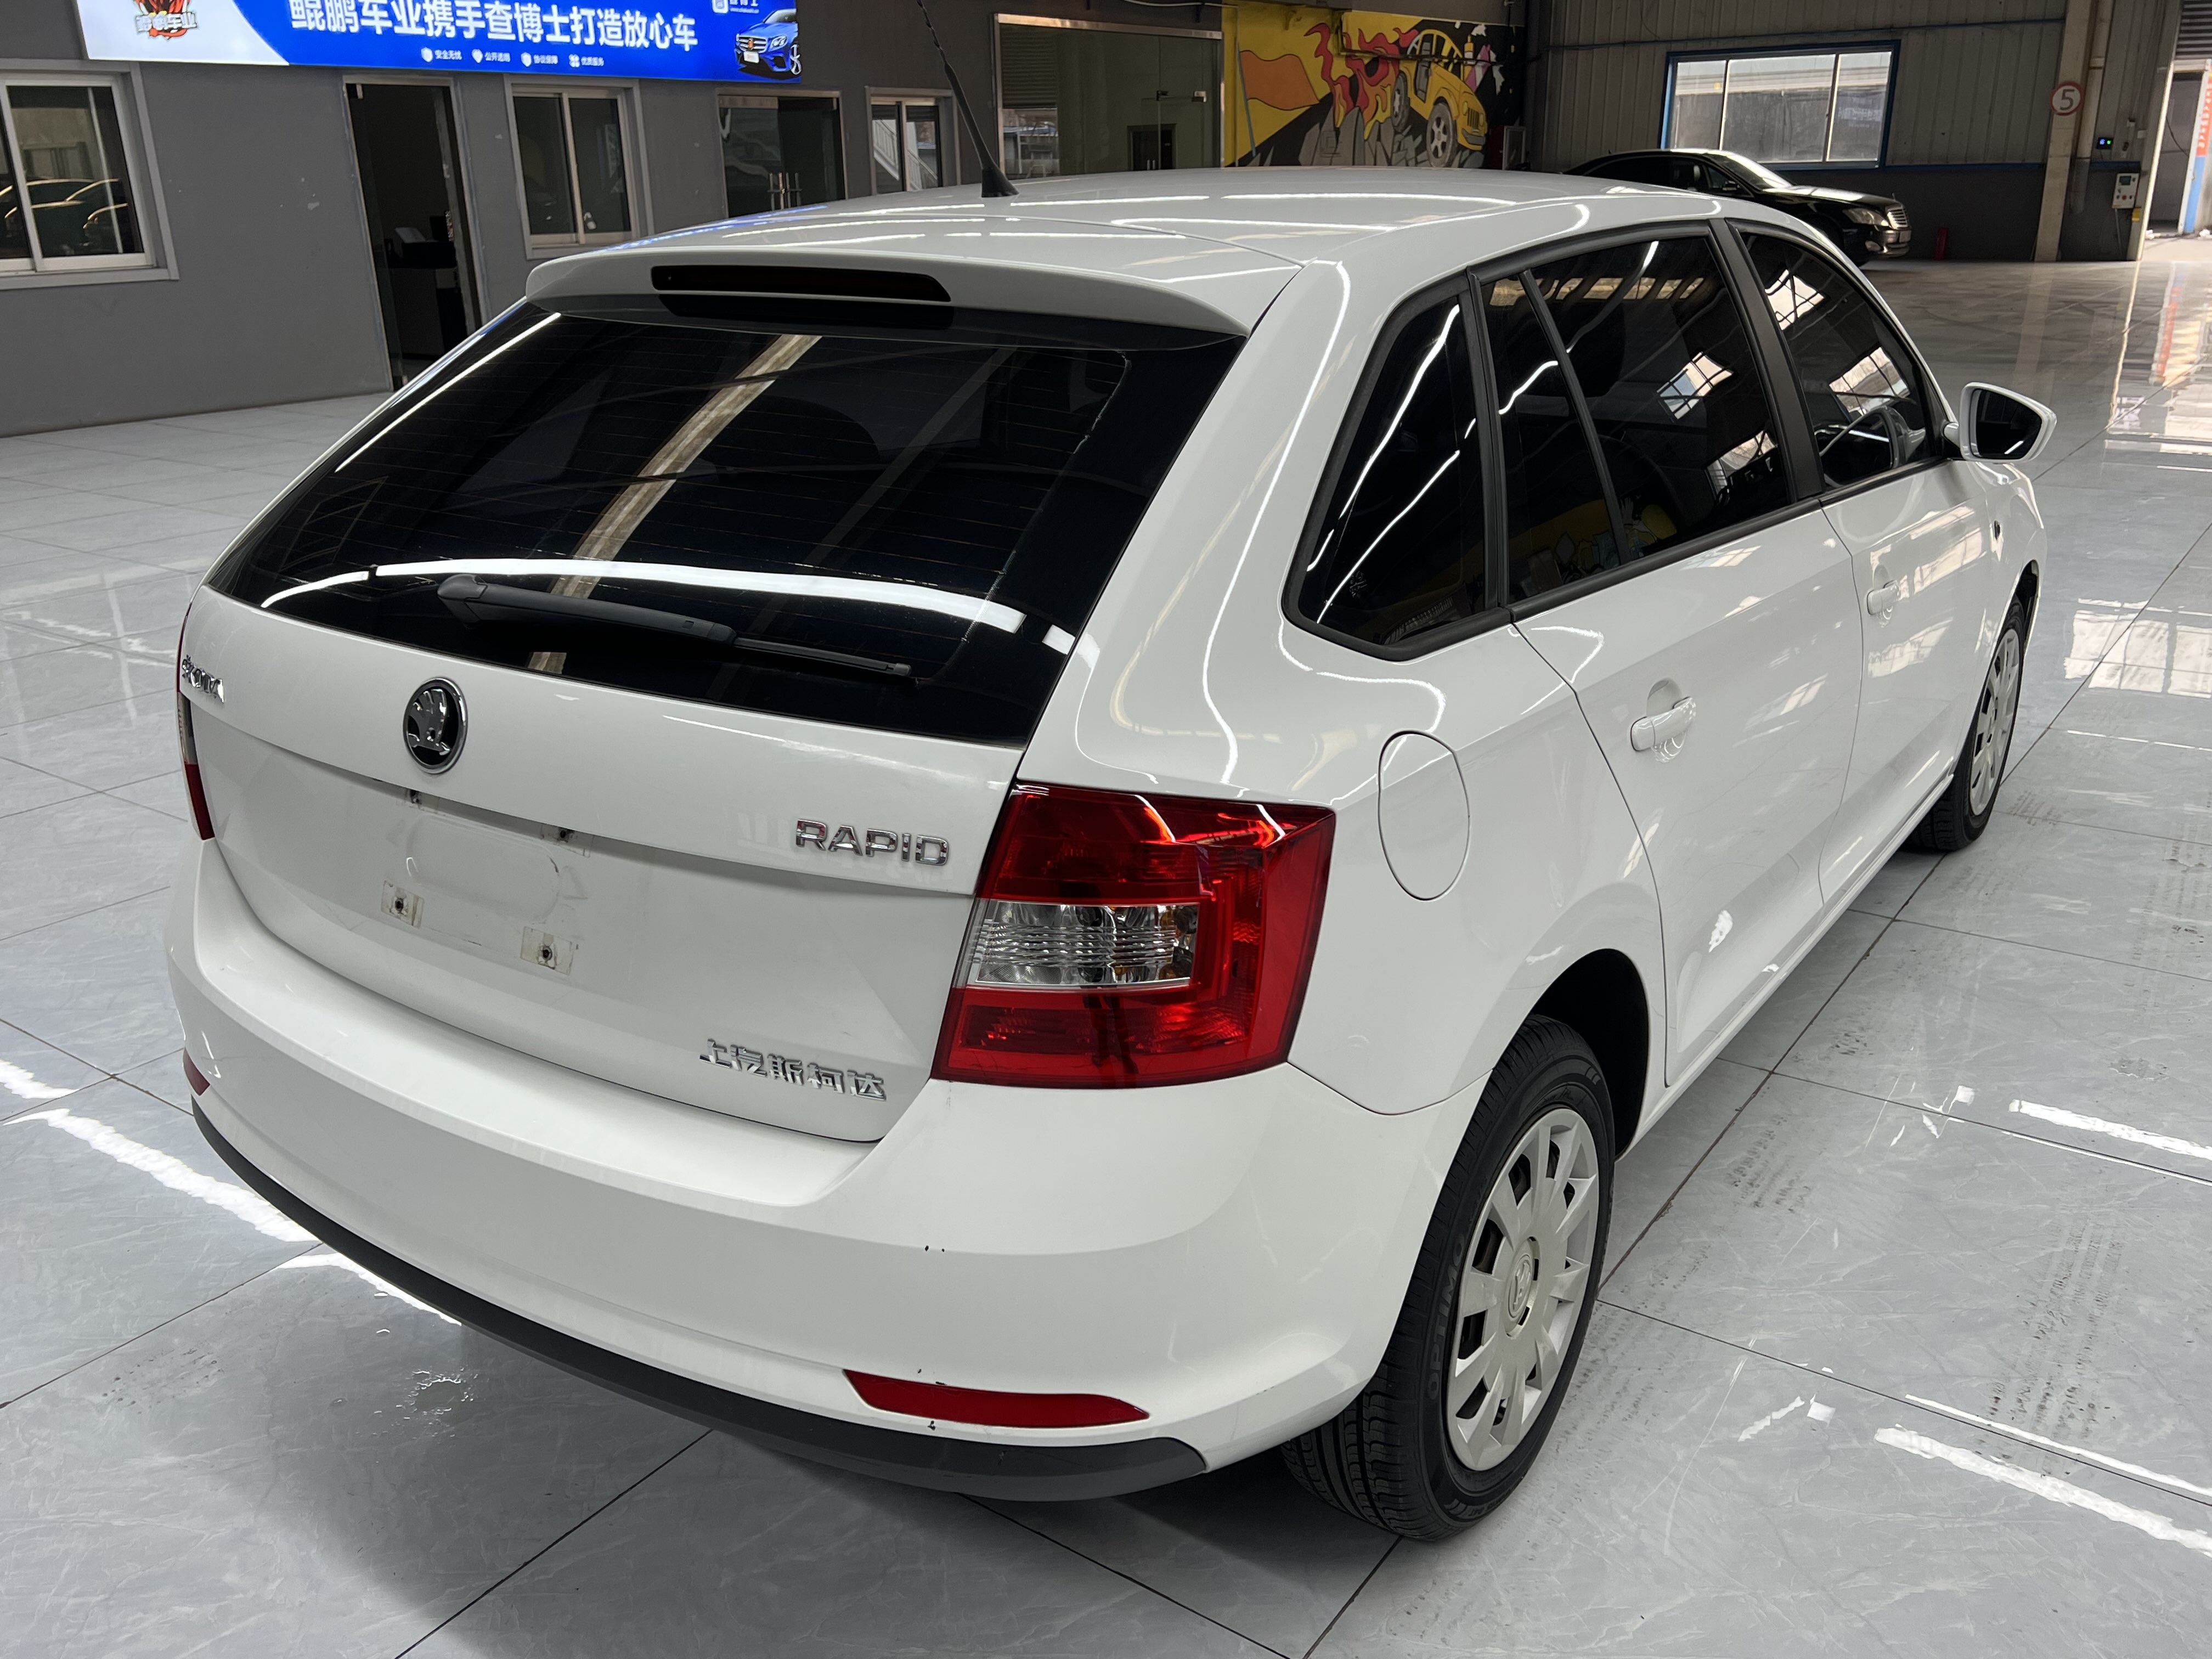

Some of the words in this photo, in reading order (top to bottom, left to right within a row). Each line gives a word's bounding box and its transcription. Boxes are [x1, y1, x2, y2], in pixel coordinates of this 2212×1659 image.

[289, 0, 698, 52] 鲲鹏车业携手查博士打造放心车
[2060, 89, 2075, 110] 5
[795, 818, 950, 867] RAPID
[699, 1038, 888, 1102] 上汽斯柯达
[1426, 1232, 1465, 1401] OPTIMO
